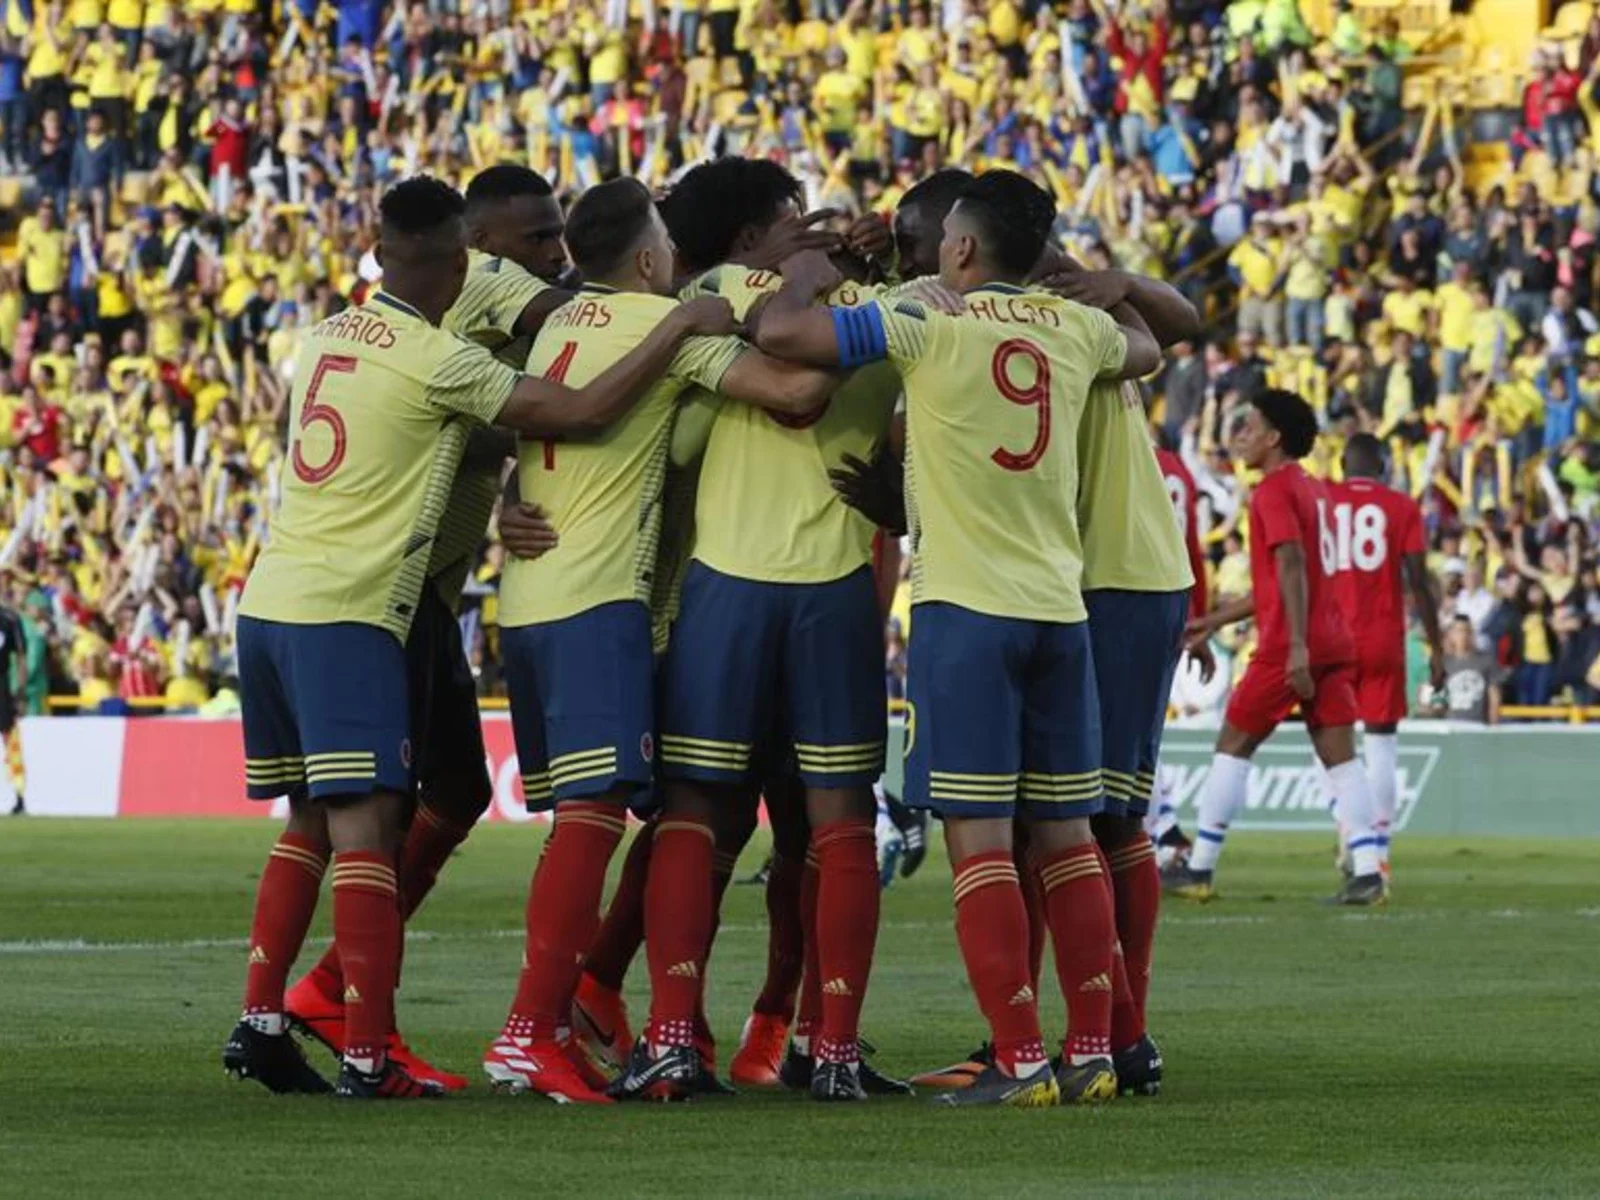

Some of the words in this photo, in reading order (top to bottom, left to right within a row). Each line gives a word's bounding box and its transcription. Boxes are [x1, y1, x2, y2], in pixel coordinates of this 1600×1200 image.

[292, 353, 358, 484] 5
[990, 337, 1052, 472] 9
[1334, 503, 1388, 572] 18
